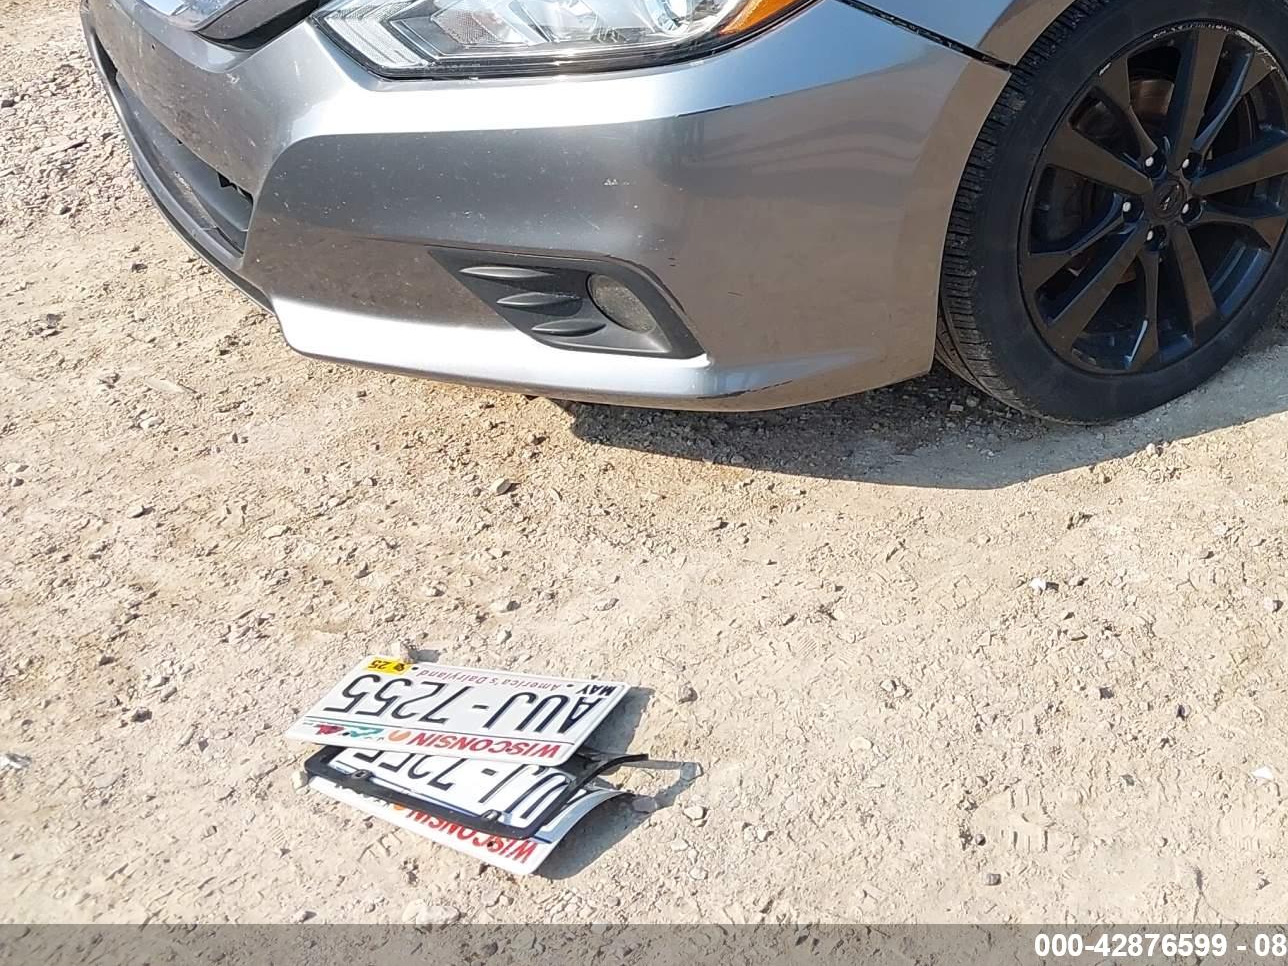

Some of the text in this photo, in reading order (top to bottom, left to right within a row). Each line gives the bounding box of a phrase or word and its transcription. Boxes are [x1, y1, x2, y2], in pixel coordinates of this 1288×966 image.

[415, 668, 562, 692] America's Dairyland
[576, 684, 617, 697] MAY
[407, 732, 561, 758] WISCONSIN
